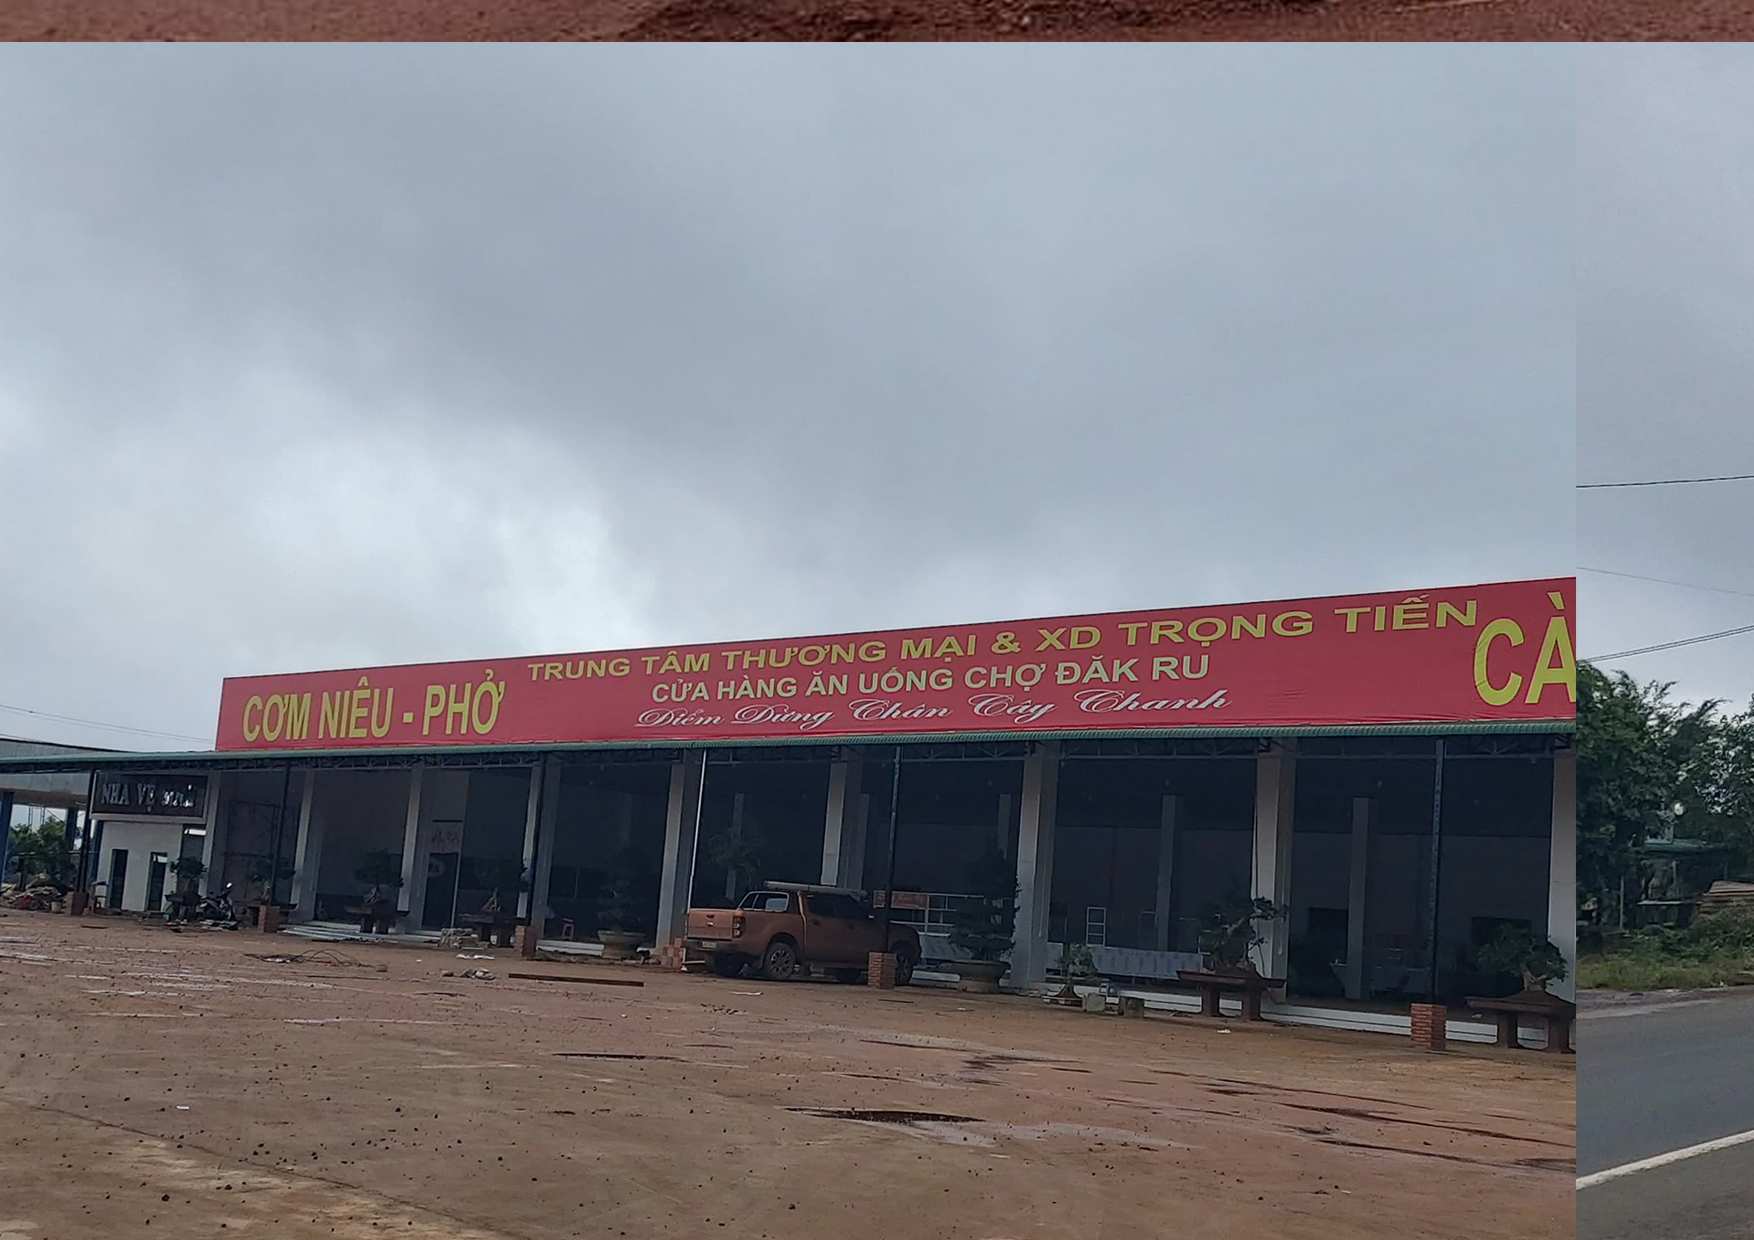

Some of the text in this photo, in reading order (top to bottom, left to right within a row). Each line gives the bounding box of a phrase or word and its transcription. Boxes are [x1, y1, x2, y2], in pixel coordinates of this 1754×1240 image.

[527, 594, 1477, 681] TRUNG TÂM THƯƠNG MẠI & XD TRỌNG TIẾN
[243, 692, 311, 742] CƠM
[317, 676, 394, 739] NIÊU
[422, 669, 505, 735] PHỞ
[651, 678, 710, 703] CỬA
[716, 674, 797, 700] HÀNG
[805, 670, 848, 696] ĂN
[963, 663, 1046, 692] CHỢ
[1055, 655, 1139, 685] ĐĂK
[1152, 654, 1209, 681] RU
[1073, 689, 1232, 713] Chanh
